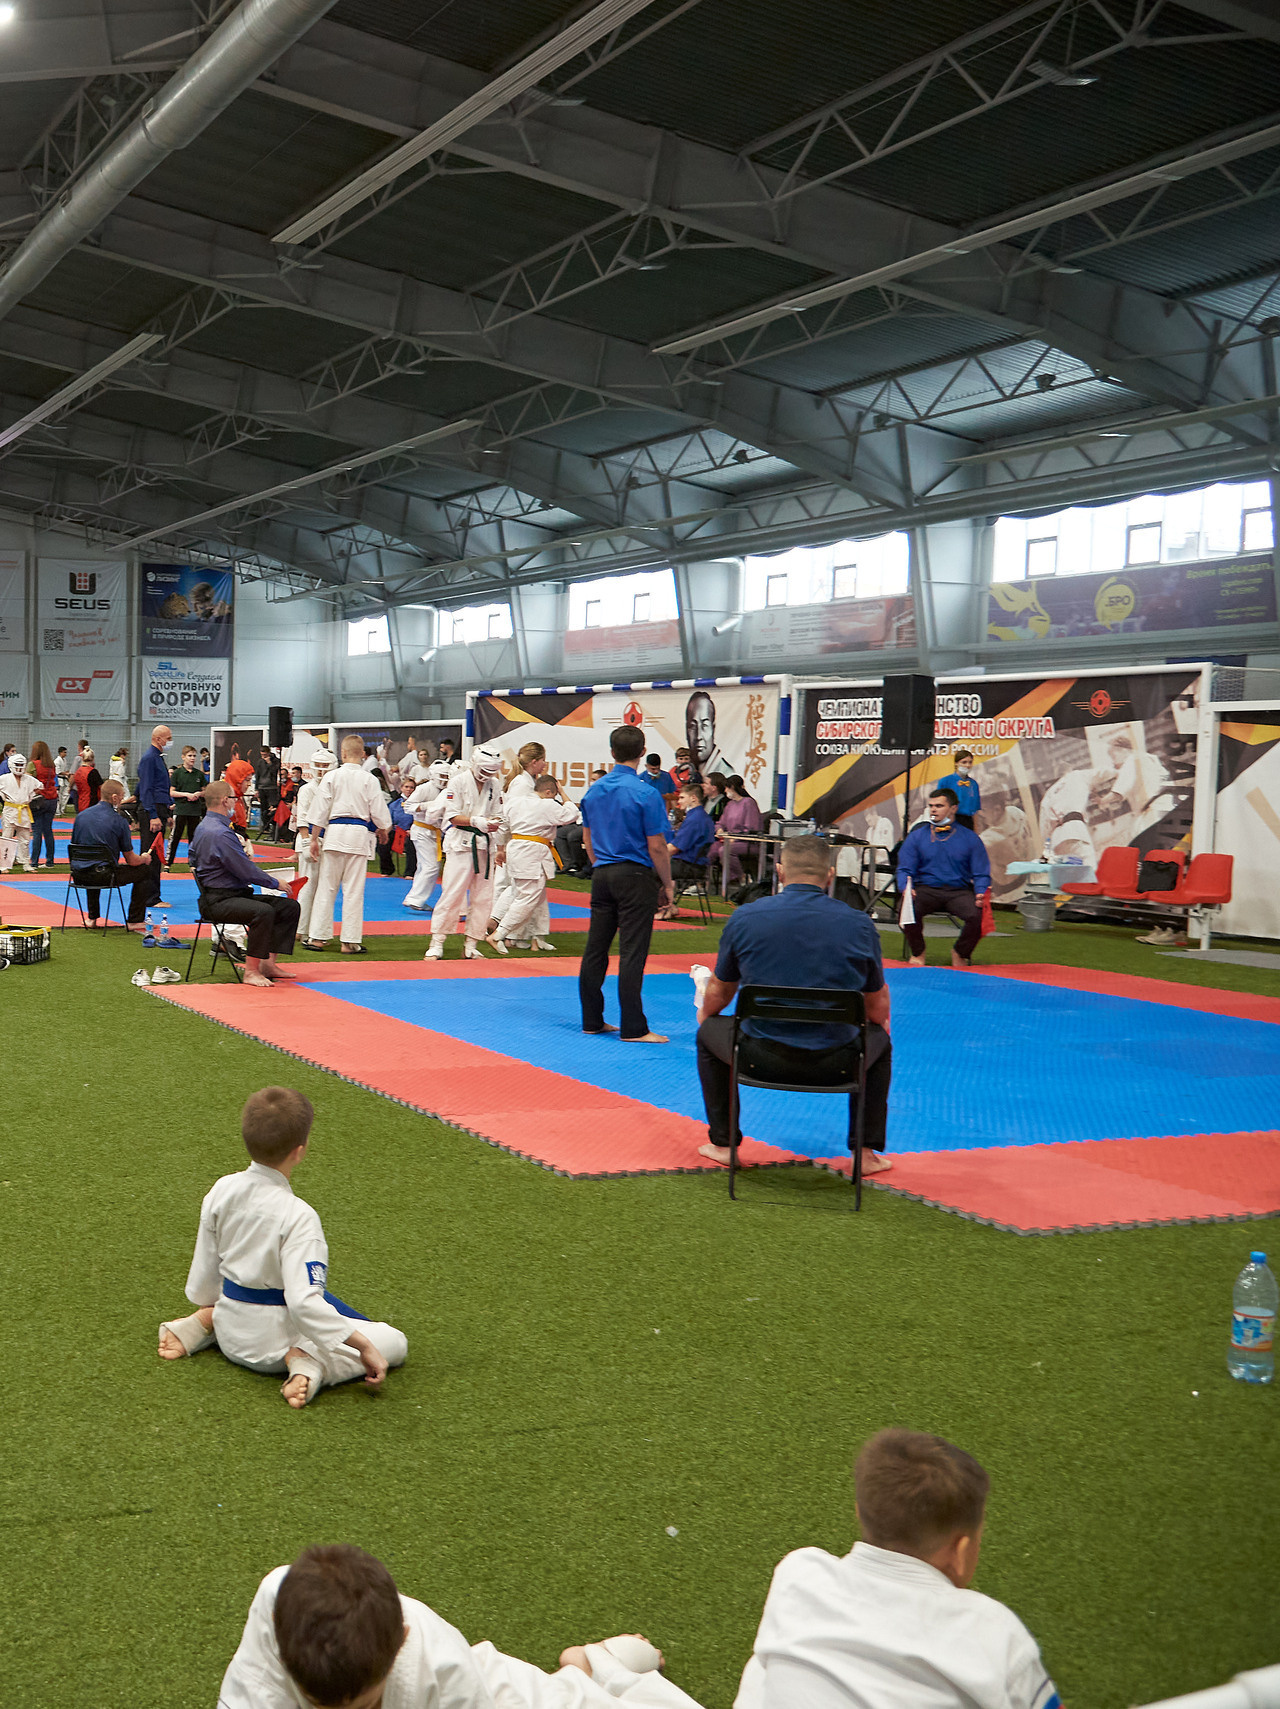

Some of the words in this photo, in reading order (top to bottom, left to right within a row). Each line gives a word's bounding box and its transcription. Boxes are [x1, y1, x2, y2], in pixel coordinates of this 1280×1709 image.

[54, 598, 111, 610] SEUS
[149, 682, 221, 691] СПОРТИВНУЮ
[149, 691, 221, 707] ФОРМУ
[819, 699, 882, 718] ЧЕМПИОНА
[936, 695, 981, 716] НСТВО
[816, 722, 882, 739] СИБИРСКОГ
[934, 719, 994, 738] АЛЬНОГО
[996, 718, 1055, 738] ОКРУГА
[815, 743, 849, 755] СОЮЗА
